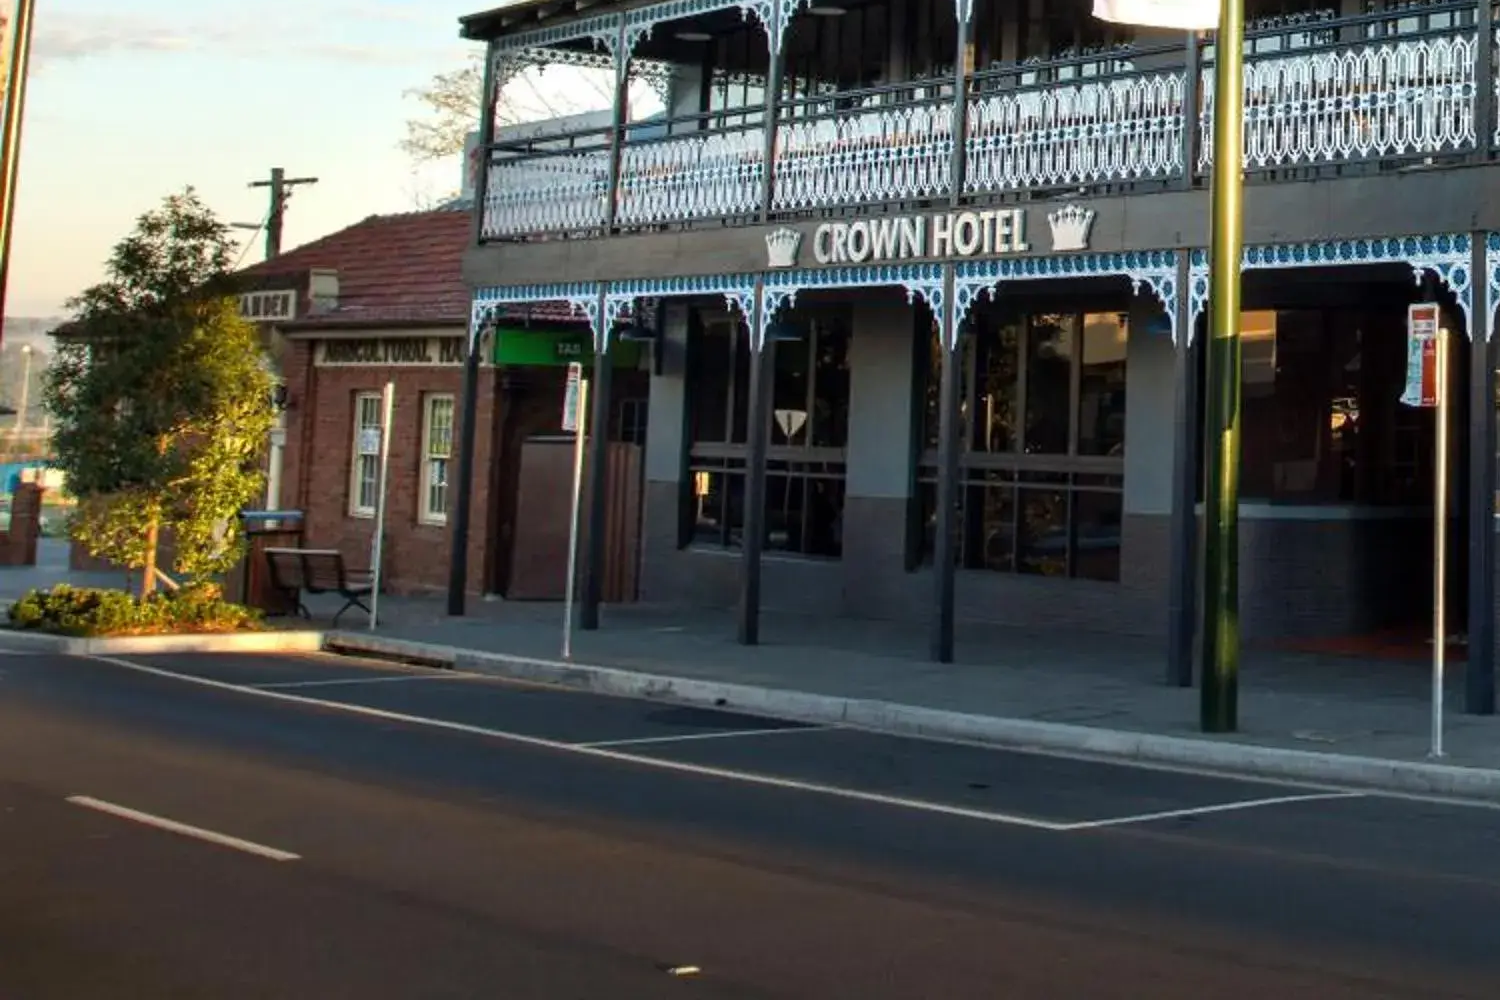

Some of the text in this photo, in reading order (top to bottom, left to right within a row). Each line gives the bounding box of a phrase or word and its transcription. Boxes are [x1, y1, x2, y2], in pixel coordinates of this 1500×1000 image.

[812, 208, 1030, 265] CROWN HOTEL
[241, 294, 291, 317] AMDEN
